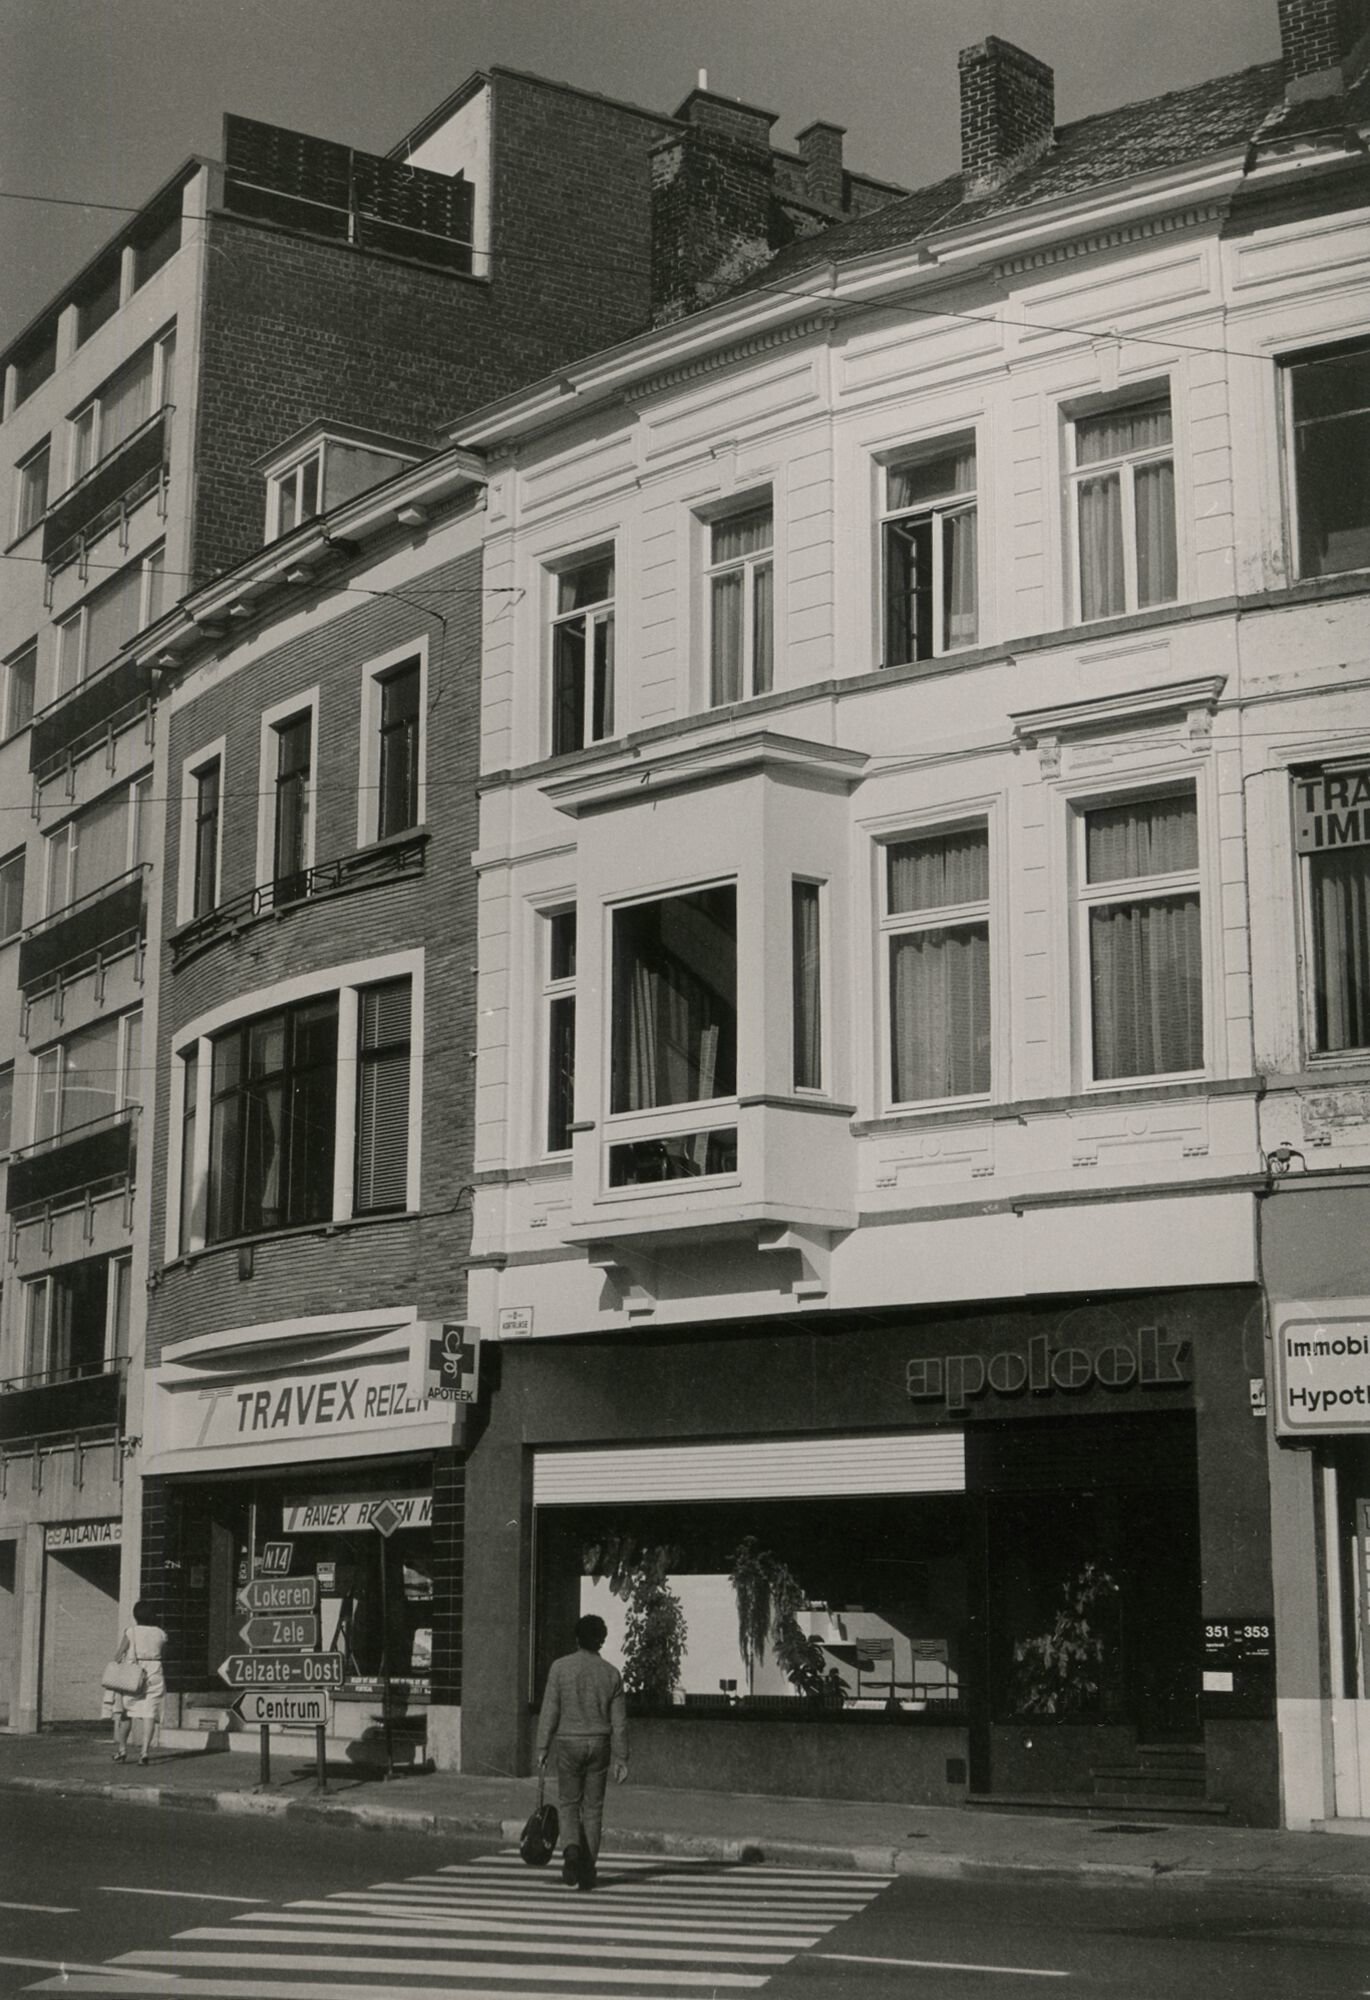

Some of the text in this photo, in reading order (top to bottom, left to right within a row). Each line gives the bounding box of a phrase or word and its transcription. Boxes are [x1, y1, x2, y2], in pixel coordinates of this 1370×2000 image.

[237, 1378, 359, 1432] TRAVEX
[427, 1386, 473, 1402] APOTEEK
[1289, 1386, 1370, 1412] Hypot
[264, 1547, 289, 1570] N14
[254, 1585, 310, 1607] Lokeren
[272, 1622, 305, 1643] Zele
[1205, 1625, 1270, 1638] 351 353
[235, 1658, 338, 1681] Zelzate-Oost
[256, 1696, 320, 1719] Centrum
